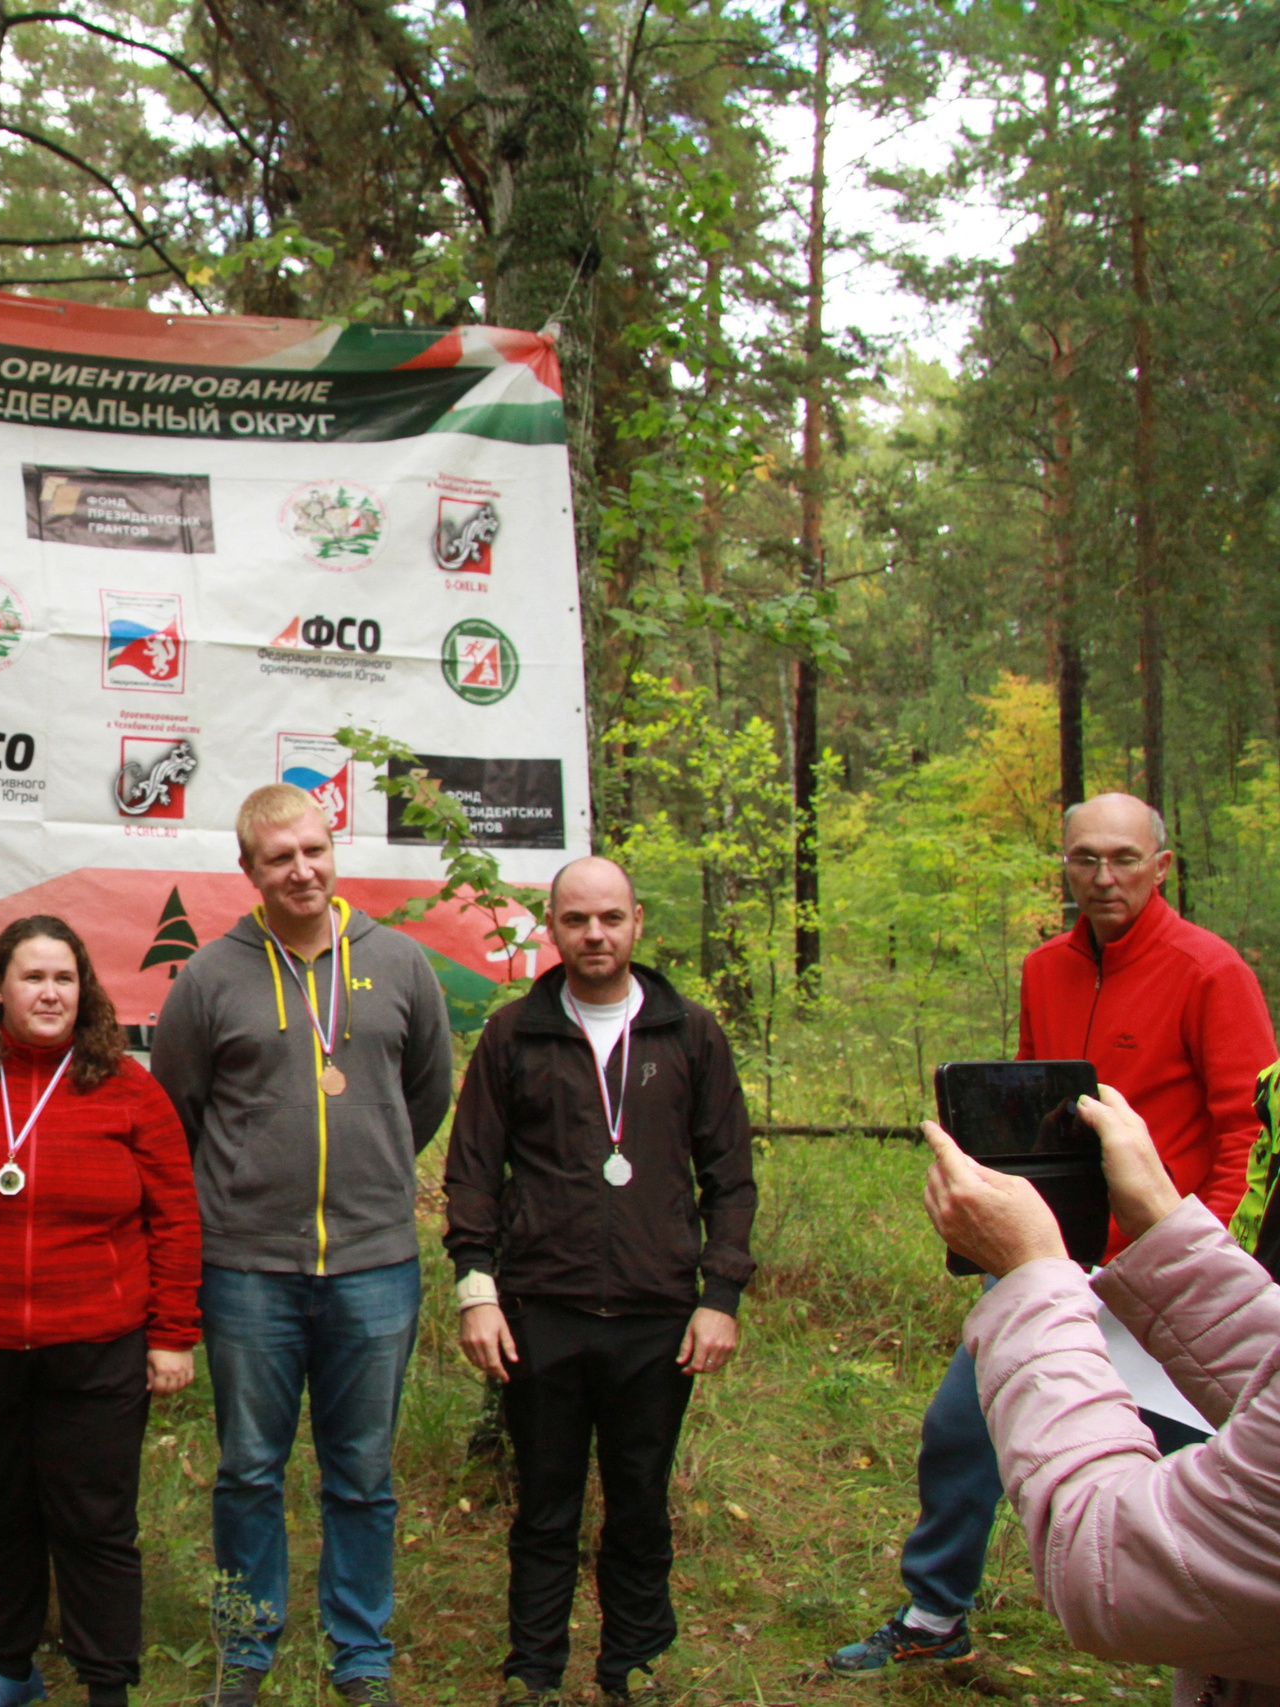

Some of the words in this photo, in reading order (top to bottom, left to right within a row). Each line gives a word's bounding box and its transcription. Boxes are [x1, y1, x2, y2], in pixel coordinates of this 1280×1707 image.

[0, 357, 333, 403] ОРИЕНТИРОВАНИЕ
[230, 410, 336, 436] ОКРУГ
[86, 495, 128, 509] ФОНД
[87, 509, 201, 526] ПРЕЗИДЕНТСКИХ
[87, 522, 150, 538] ГРАНТОВ
[301, 614, 381, 653] ФСО
[258, 648, 322, 664] Федерация
[324, 655, 392, 670] спортивного
[260, 664, 352, 679] ориентирования
[355, 669, 385, 683] Югры
[2, 789, 39, 803] Югры
[460, 806, 553, 819] ЕЗИДЕНТСКИХ
